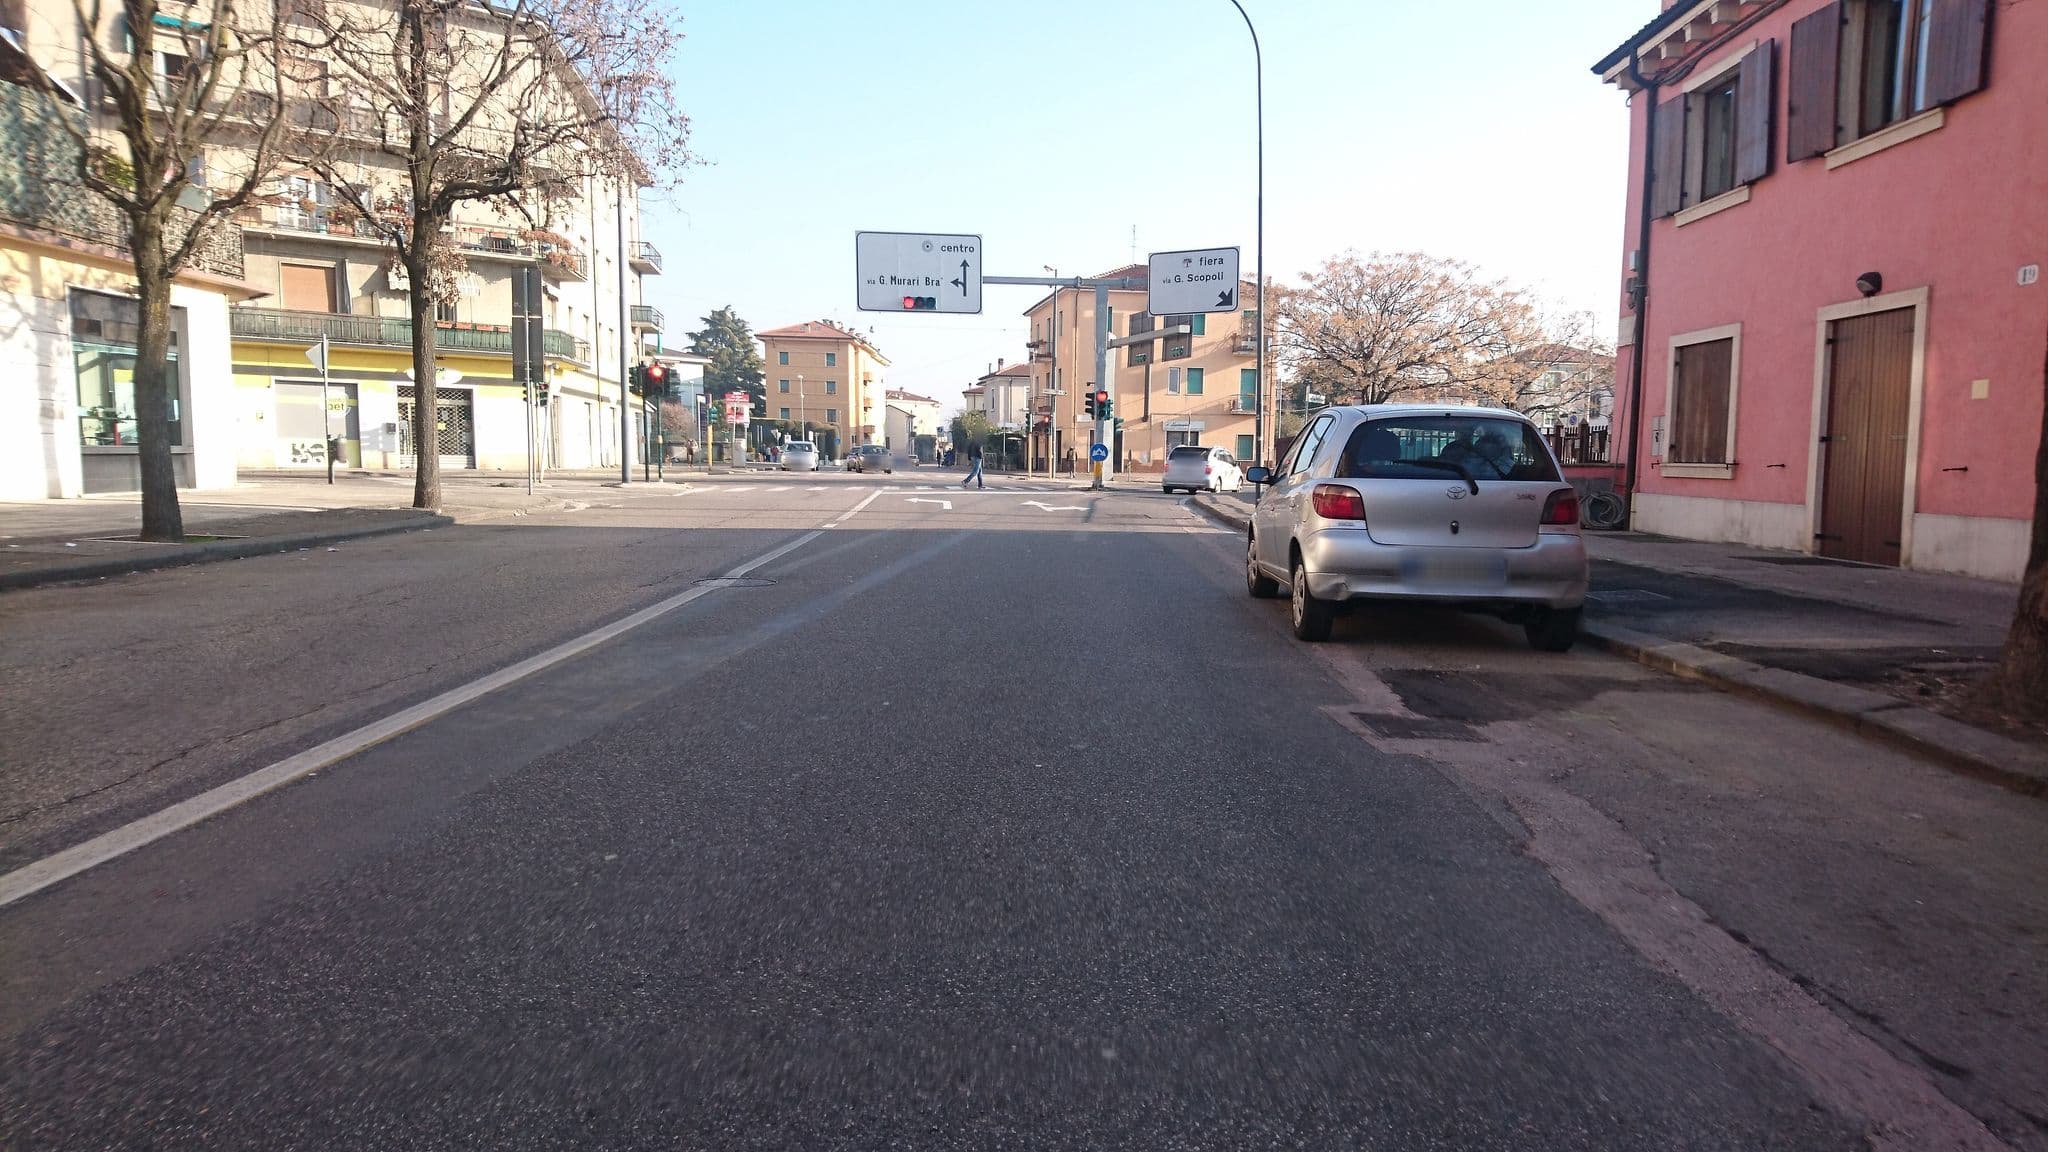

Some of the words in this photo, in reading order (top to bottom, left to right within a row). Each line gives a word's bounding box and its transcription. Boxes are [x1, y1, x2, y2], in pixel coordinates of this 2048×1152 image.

[940, 243, 975, 253] centro
[1199, 256, 1224, 266] fiera
[879, 275, 888, 285] G.
[890, 275, 920, 286] Murari
[1162, 276, 1171, 284] via
[1174, 274, 1184, 283] G.
[1187, 271, 1224, 283] Scopoli
